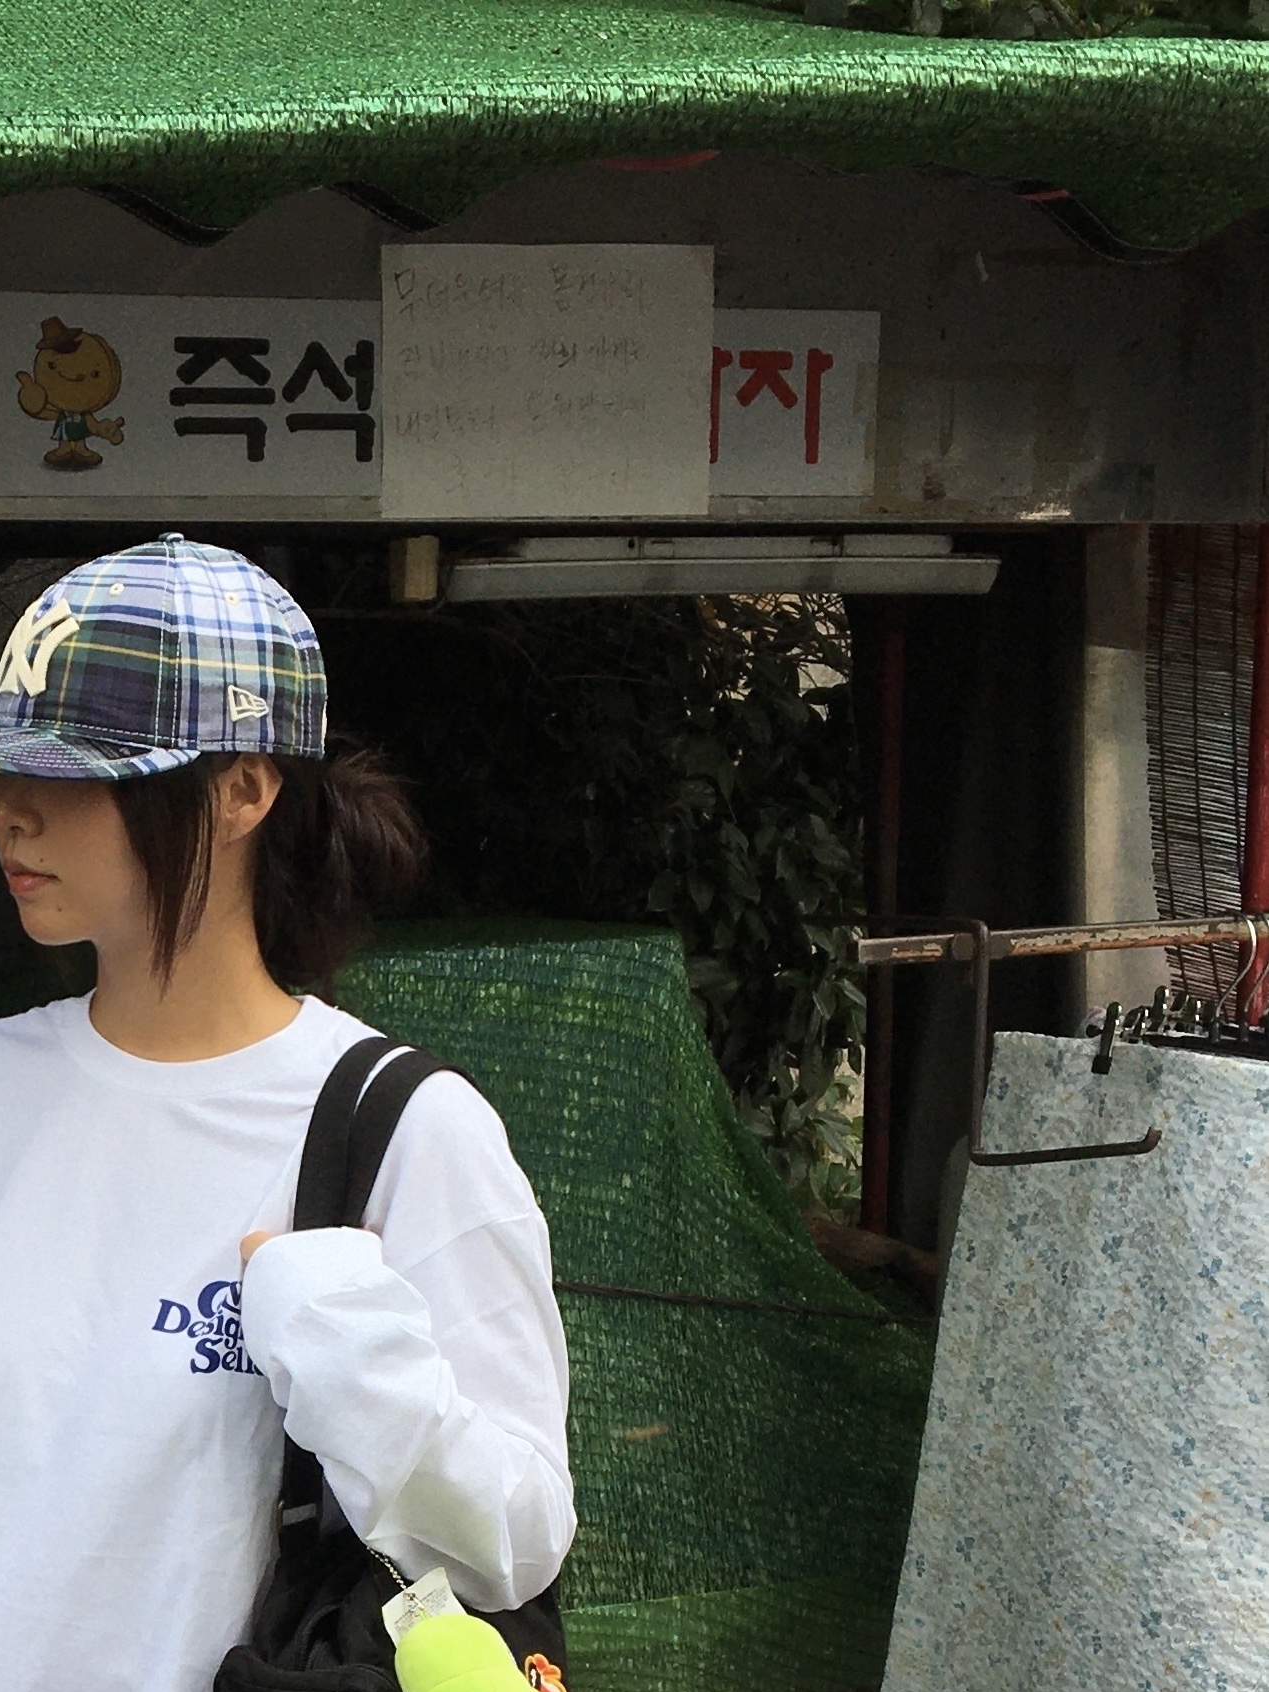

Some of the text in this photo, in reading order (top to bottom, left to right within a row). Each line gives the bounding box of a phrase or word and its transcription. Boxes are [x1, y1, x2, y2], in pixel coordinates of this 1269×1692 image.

[170, 335, 376, 463] 즉석
[151, 1298, 245, 1350] Desig
[190, 1337, 266, 1377] Sell
